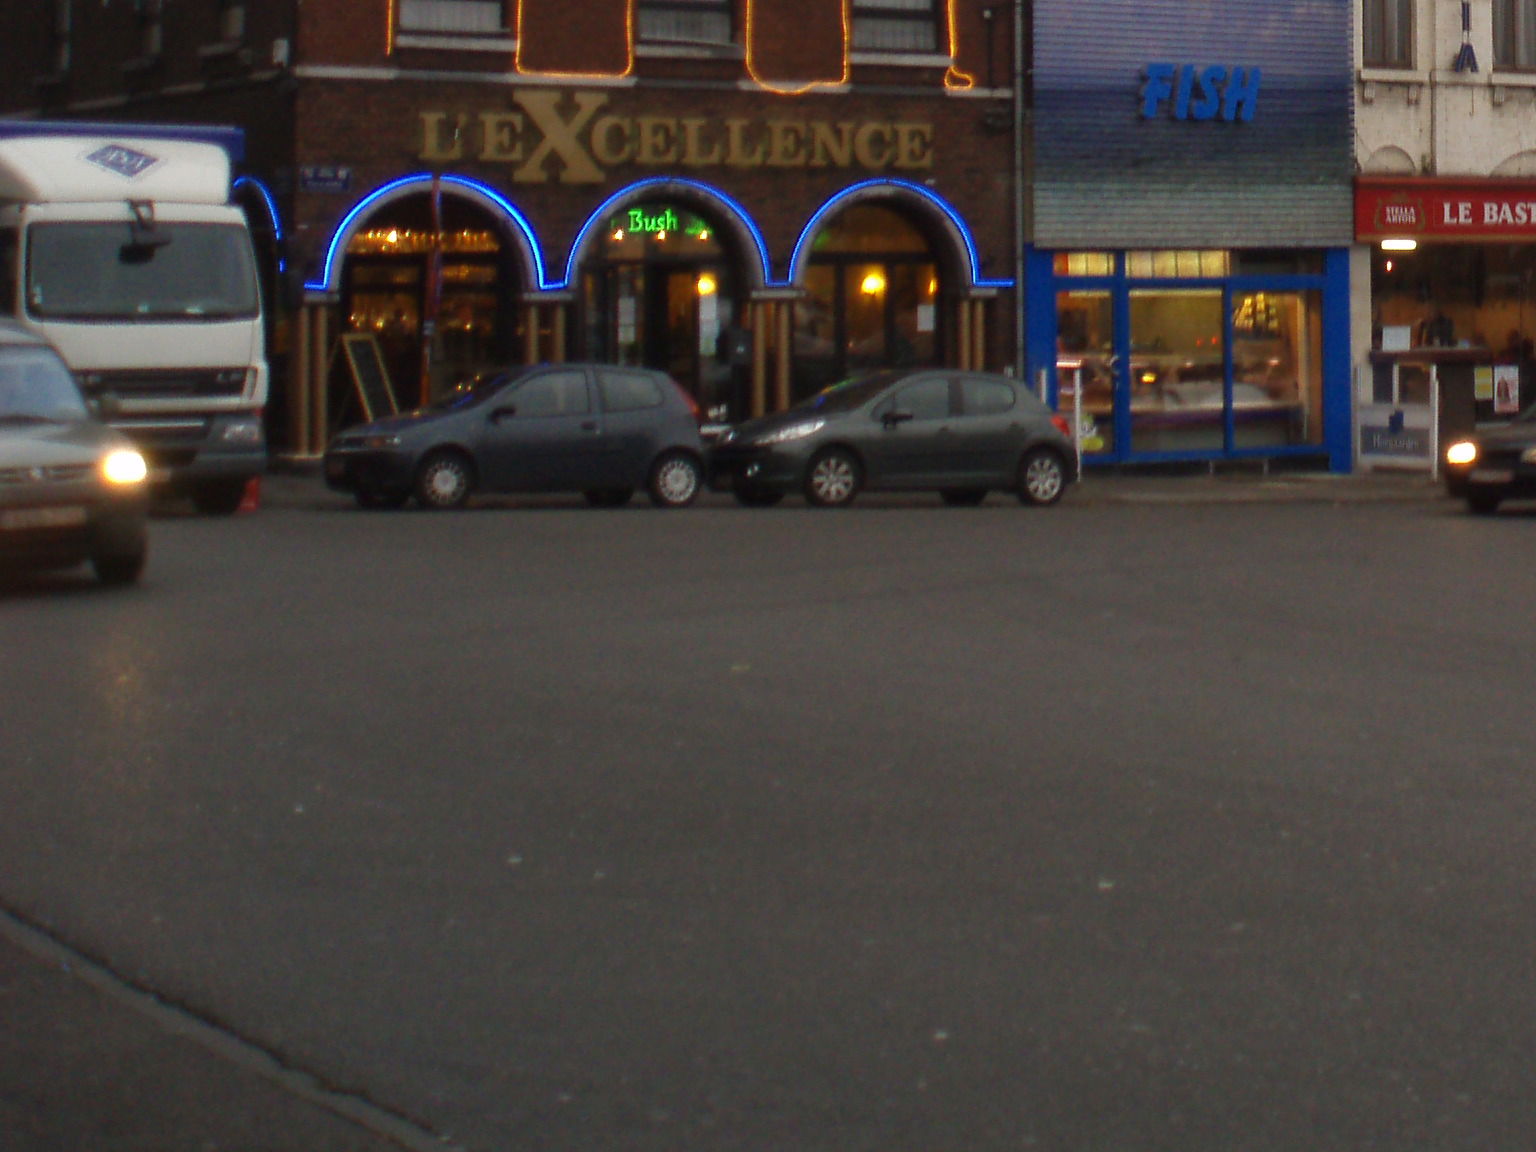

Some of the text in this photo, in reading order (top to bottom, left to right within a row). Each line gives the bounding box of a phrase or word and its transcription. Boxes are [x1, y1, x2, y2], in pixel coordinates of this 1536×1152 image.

[1141, 64, 1261, 122] FISH
[628, 208, 678, 233] Bush
[1386, 206, 1415, 215] STELLA
[1443, 202, 1472, 224] LE
